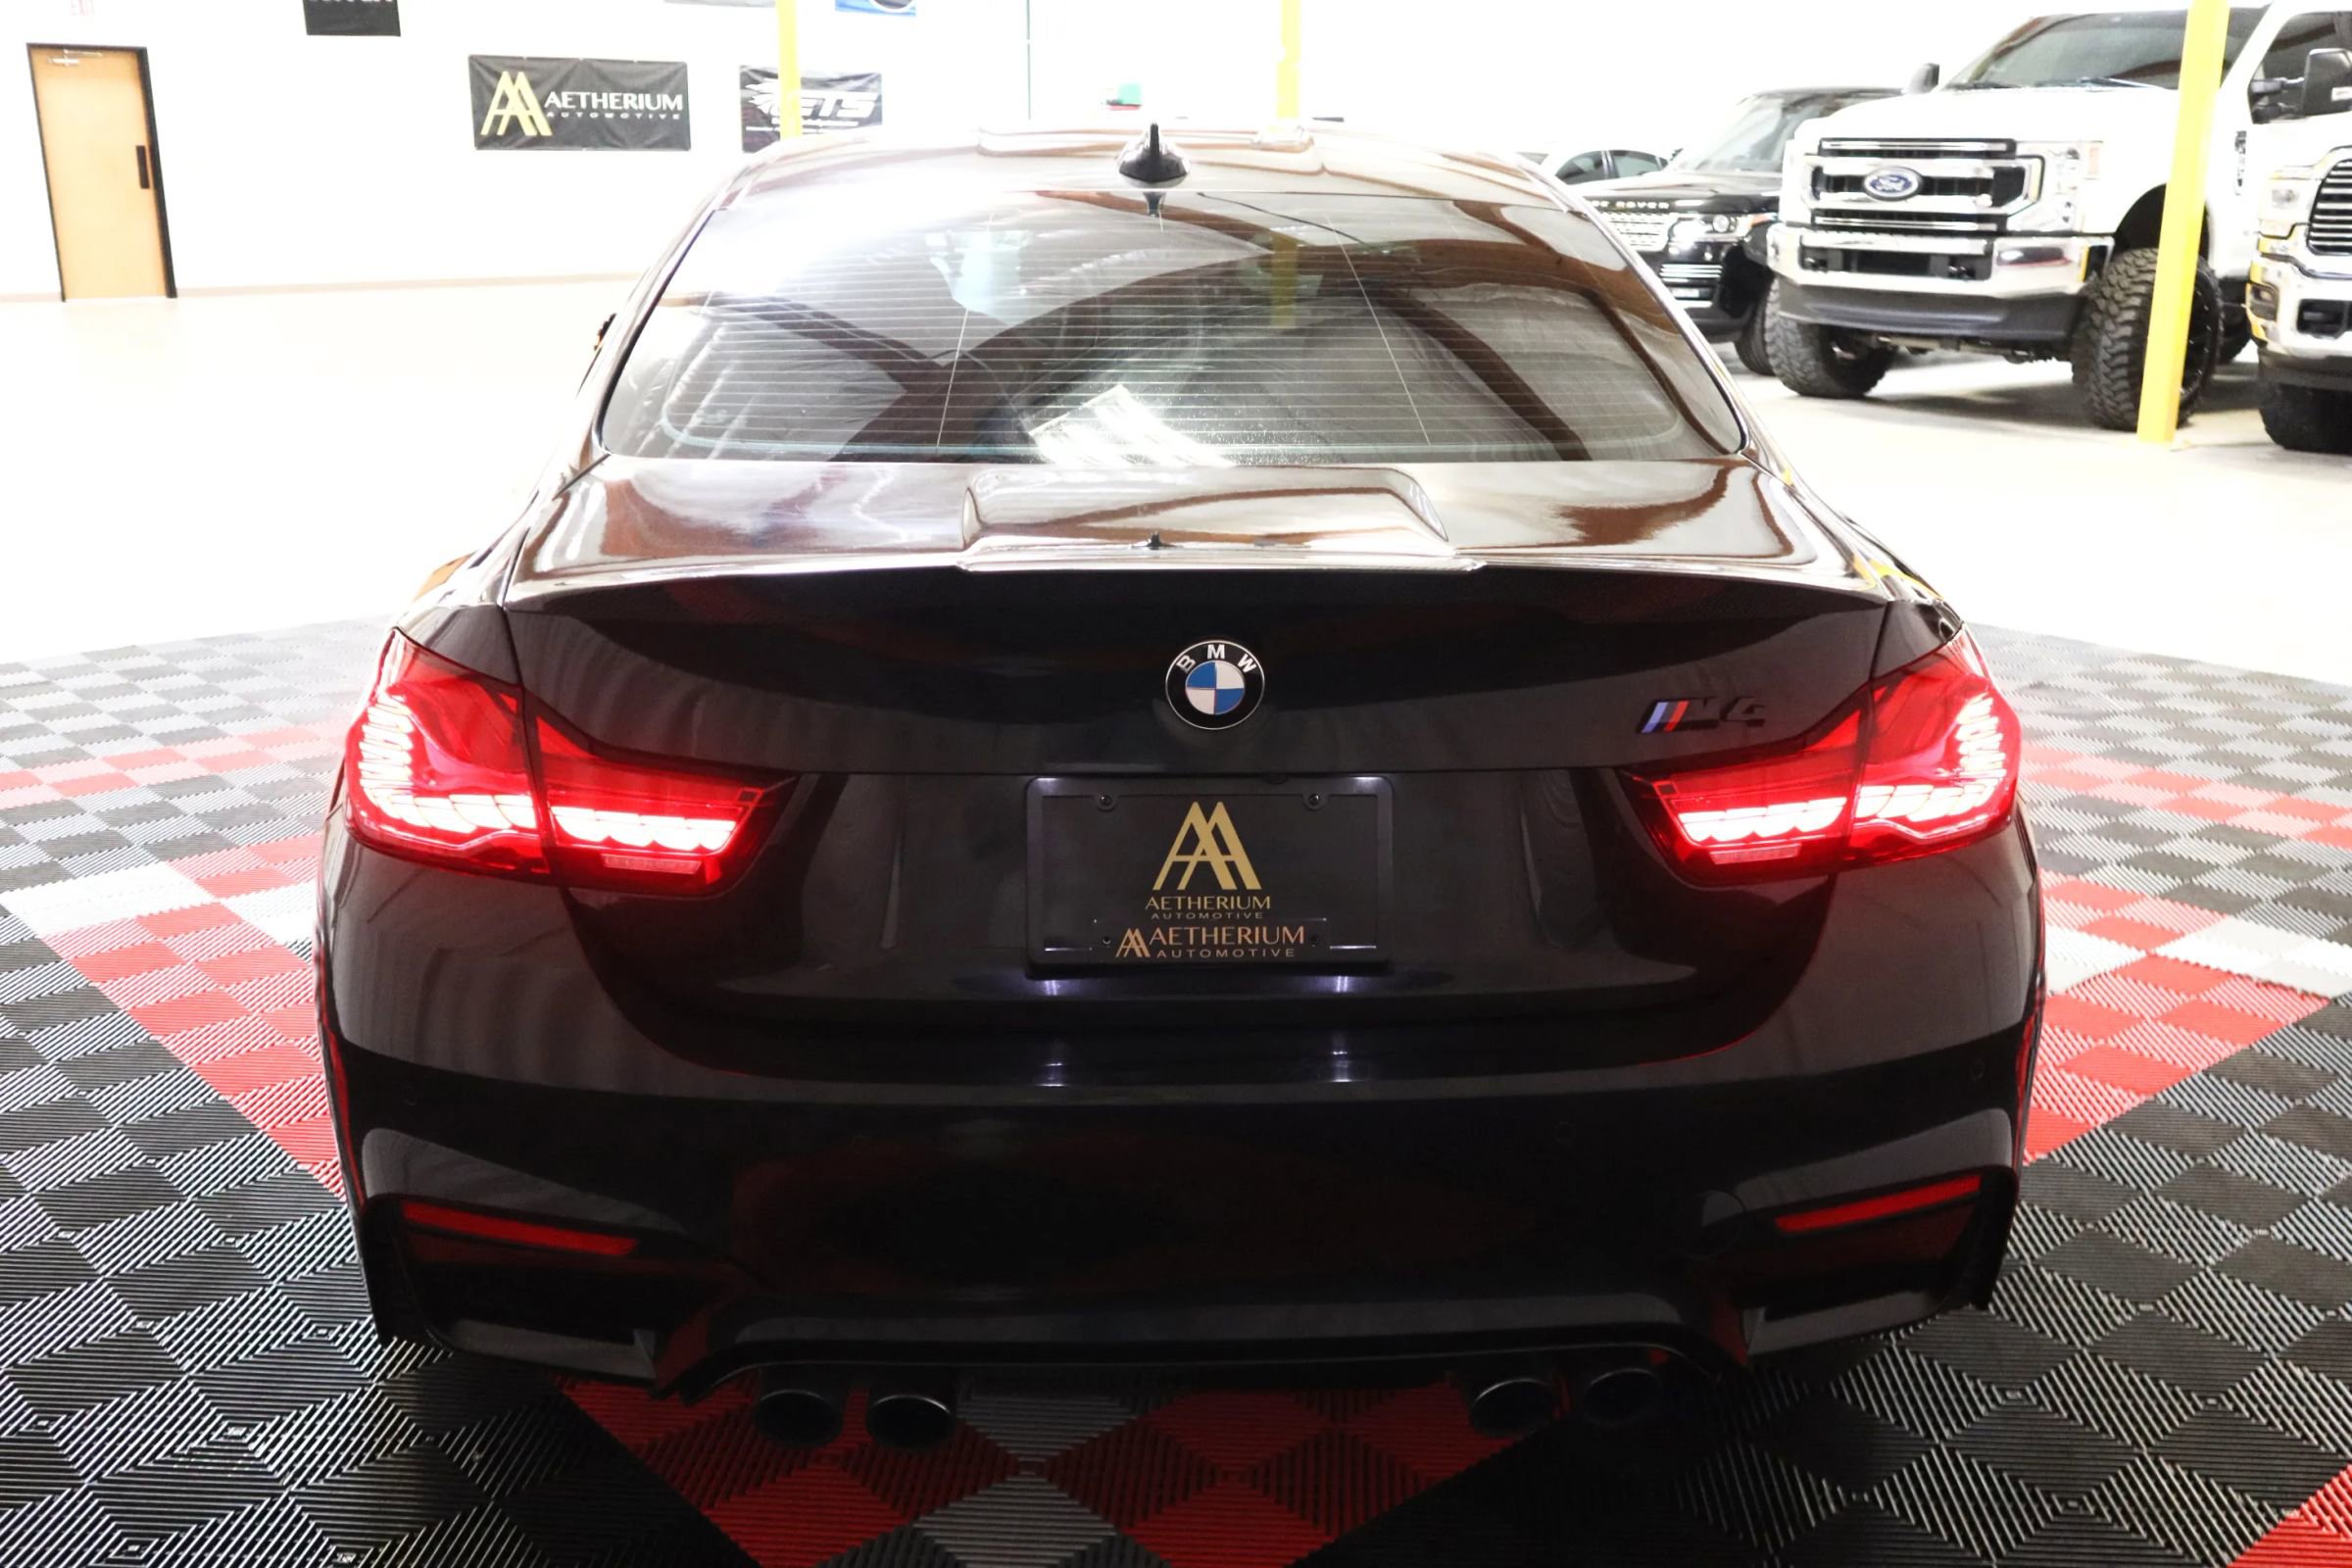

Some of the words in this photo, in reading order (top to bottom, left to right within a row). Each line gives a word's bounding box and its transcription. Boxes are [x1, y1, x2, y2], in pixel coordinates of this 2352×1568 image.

[544, 91, 684, 111] AETHERIUM
[547, 111, 680, 121] AUTOMOTIVE
[1176, 644, 1257, 674] BMW
[1145, 896, 1271, 910] AETHERIUM
[1151, 911, 1263, 920] AUTOMOTIVE
[1149, 925, 1305, 946] AETHERIUM
[1156, 948, 1296, 958] AUTOMOTIVE
